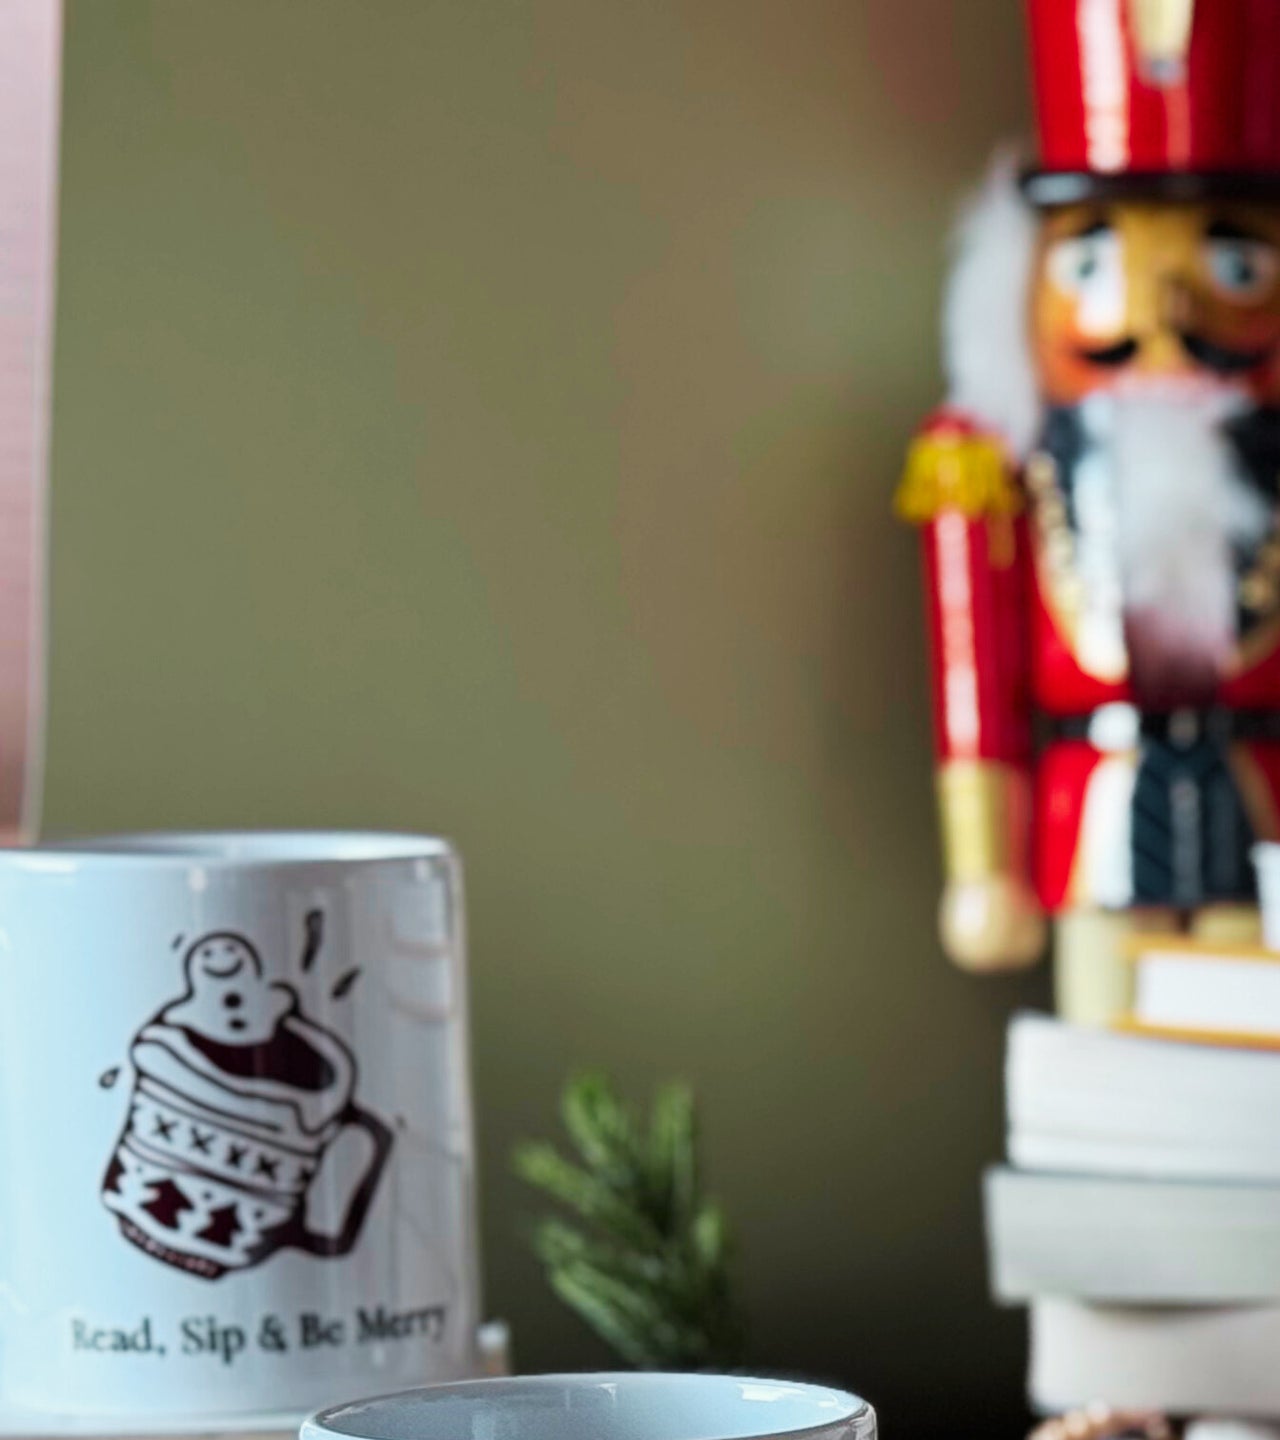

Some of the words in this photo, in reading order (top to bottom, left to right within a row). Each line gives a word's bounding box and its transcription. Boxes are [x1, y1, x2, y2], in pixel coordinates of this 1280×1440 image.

[71, 1317, 167, 1359] Read,
[181, 1316, 246, 1364] Sip
[256, 1314, 289, 1353] &
[300, 1311, 348, 1347] Be
[355, 1302, 449, 1343] Merry
